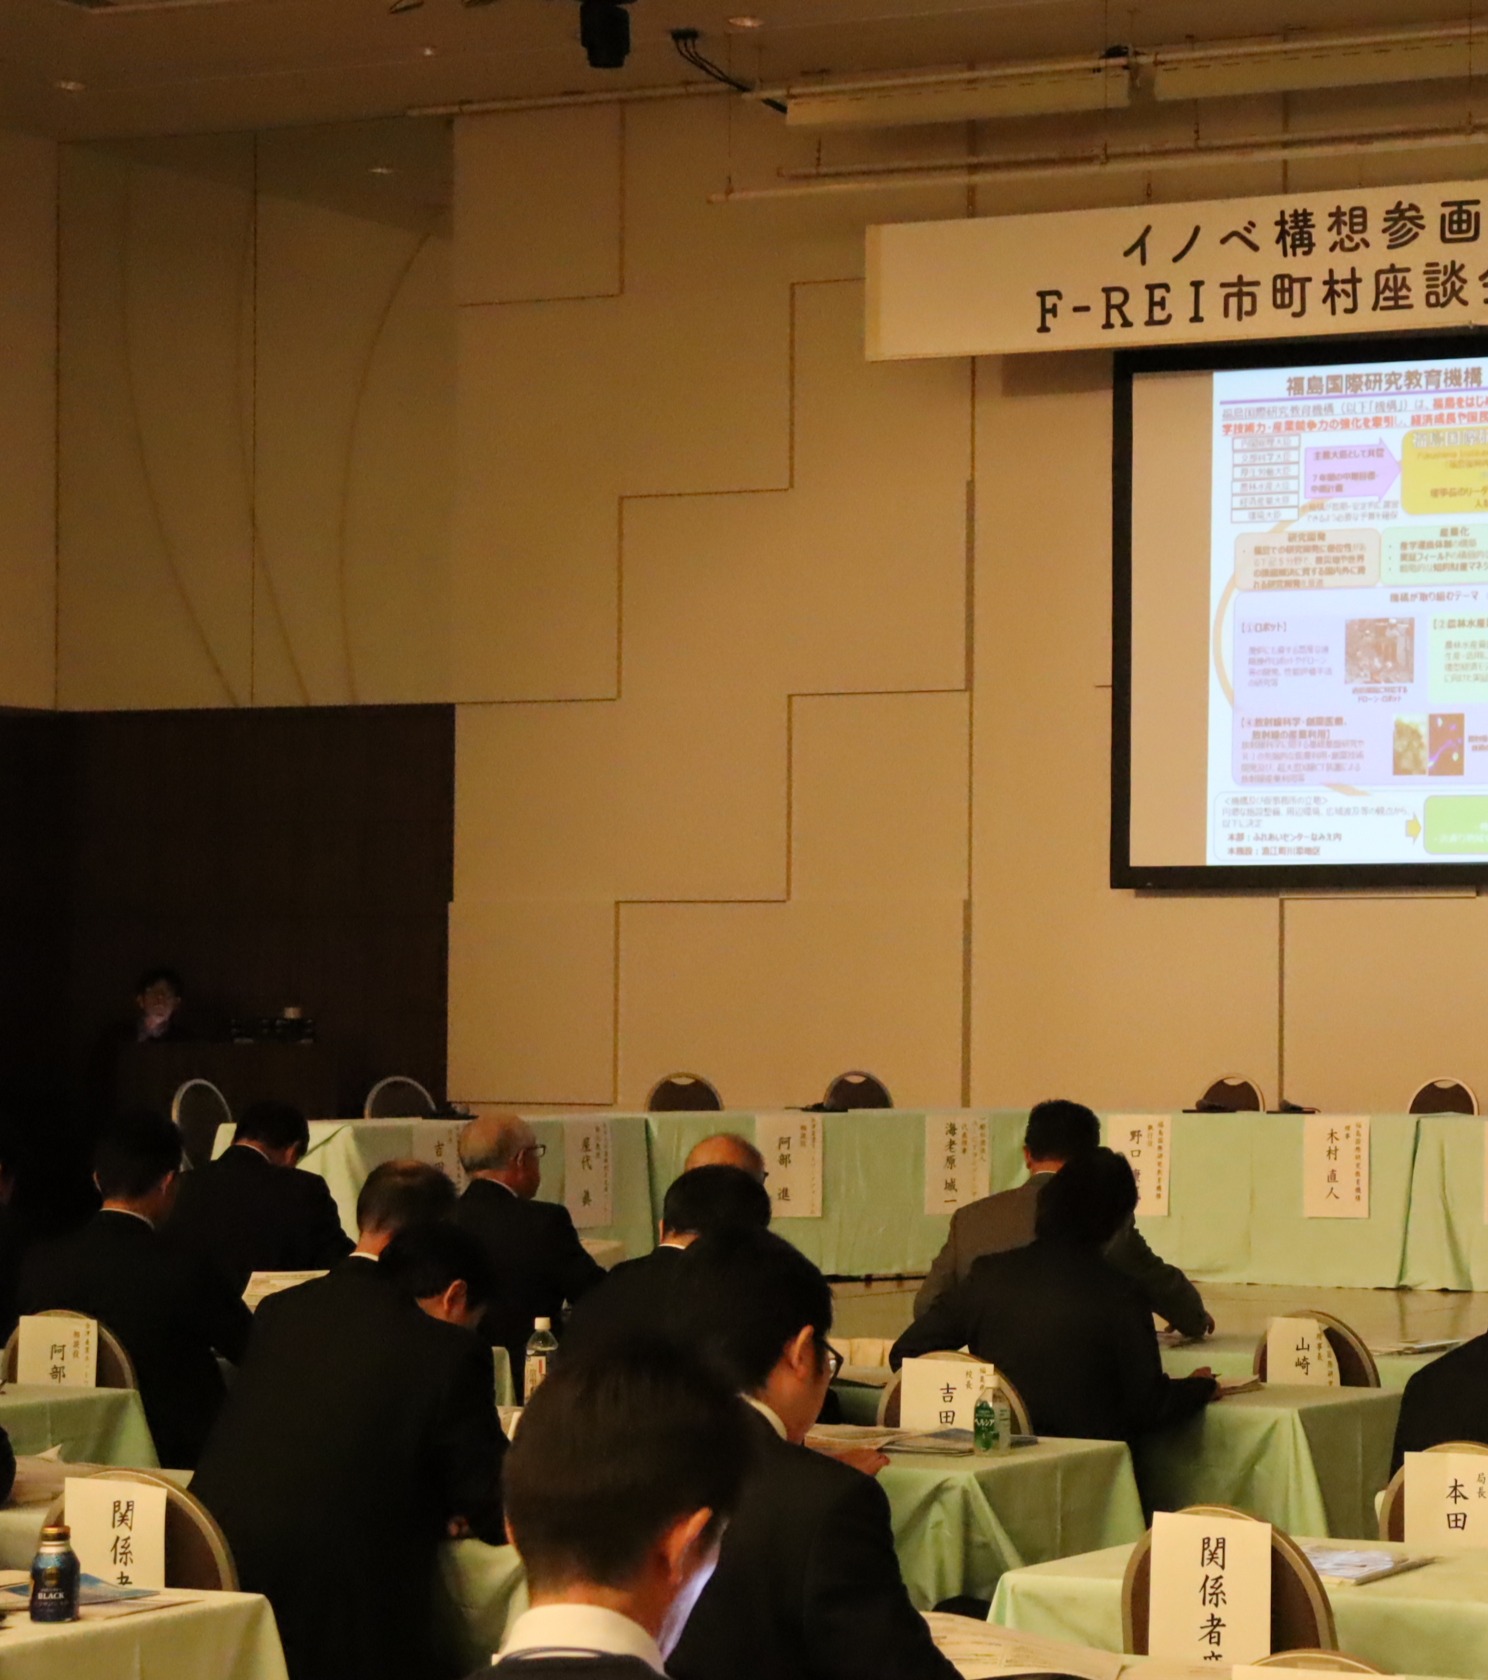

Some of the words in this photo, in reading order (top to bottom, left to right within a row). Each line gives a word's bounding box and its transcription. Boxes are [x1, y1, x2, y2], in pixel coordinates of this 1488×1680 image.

[49, 1343, 66, 1383] 阿部
[939, 1383, 957, 1425] 吉田
[1446, 1478, 1469, 1531] 本田
[1478, 1472, 1486, 1499] 局長
[38, 1592, 65, 1600] BLACK
